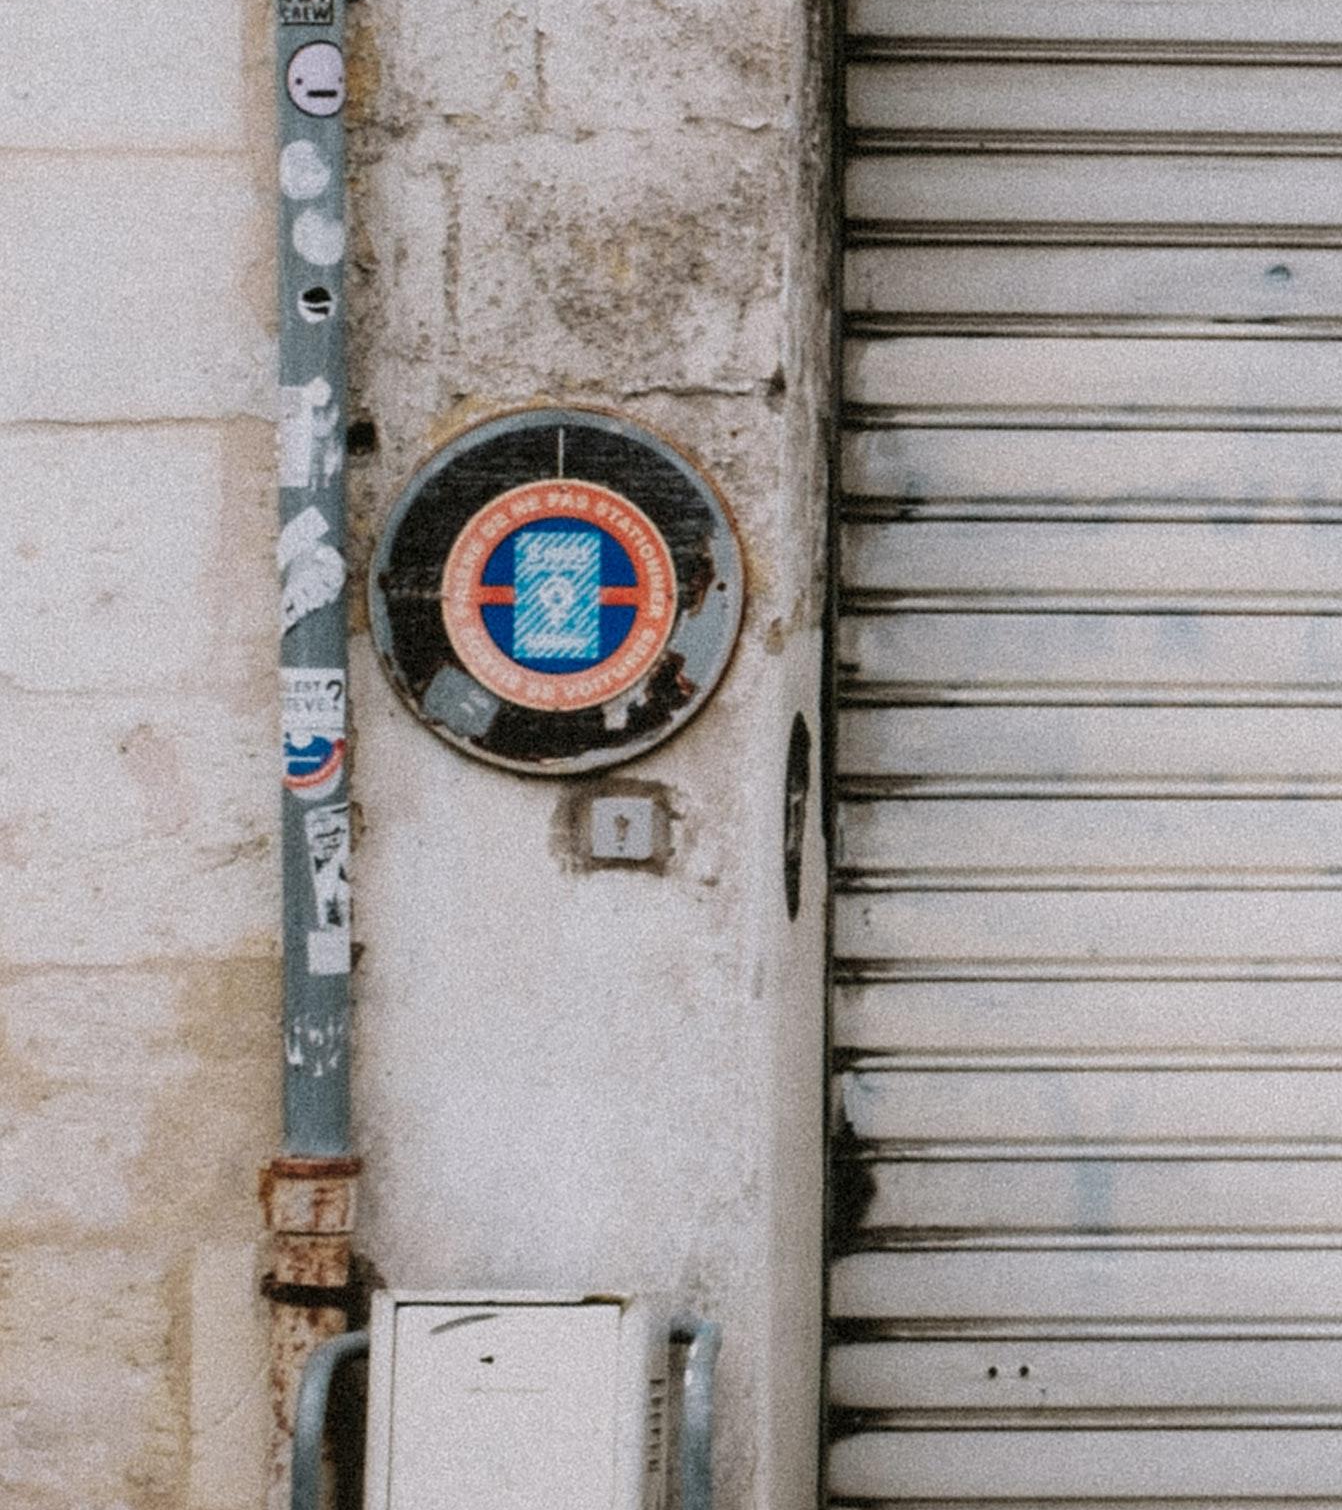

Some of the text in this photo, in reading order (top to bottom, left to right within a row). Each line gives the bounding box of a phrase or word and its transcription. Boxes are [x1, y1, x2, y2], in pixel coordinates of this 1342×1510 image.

[510, 495, 541, 517] NE
[547, 492, 589, 510] PAS
[595, 500, 663, 618] STATIONNER
[525, 678, 554, 699] DE
[563, 626, 657, 699] VOITURES
